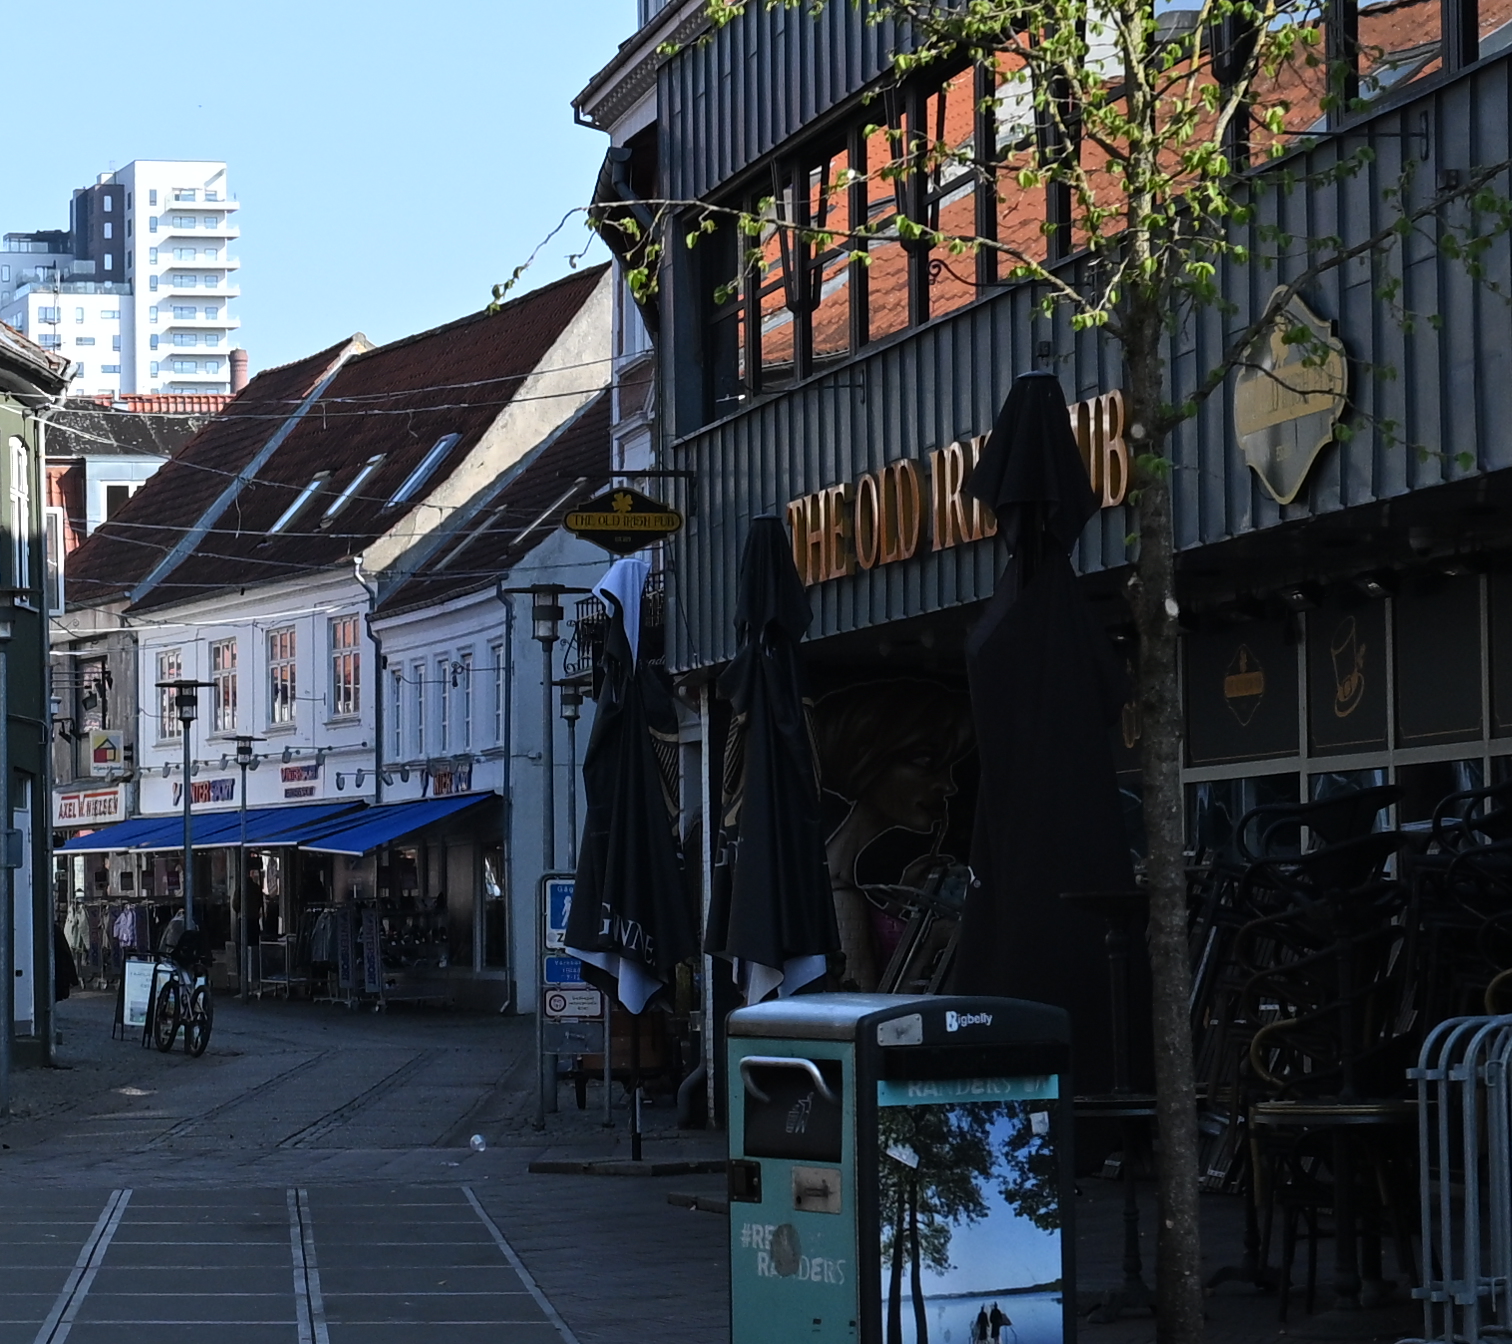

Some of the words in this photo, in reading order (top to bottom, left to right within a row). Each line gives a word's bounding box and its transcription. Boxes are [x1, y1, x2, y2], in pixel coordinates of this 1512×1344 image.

[574, 514, 595, 527] THE
[598, 514, 621, 527] OLD
[654, 515, 675, 527] PUB
[786, 482, 852, 588] THE
[854, 457, 922, 571] OLD
[58, 799, 77, 820] AXEL
[945, 1010, 993, 1033] Bigbelly
